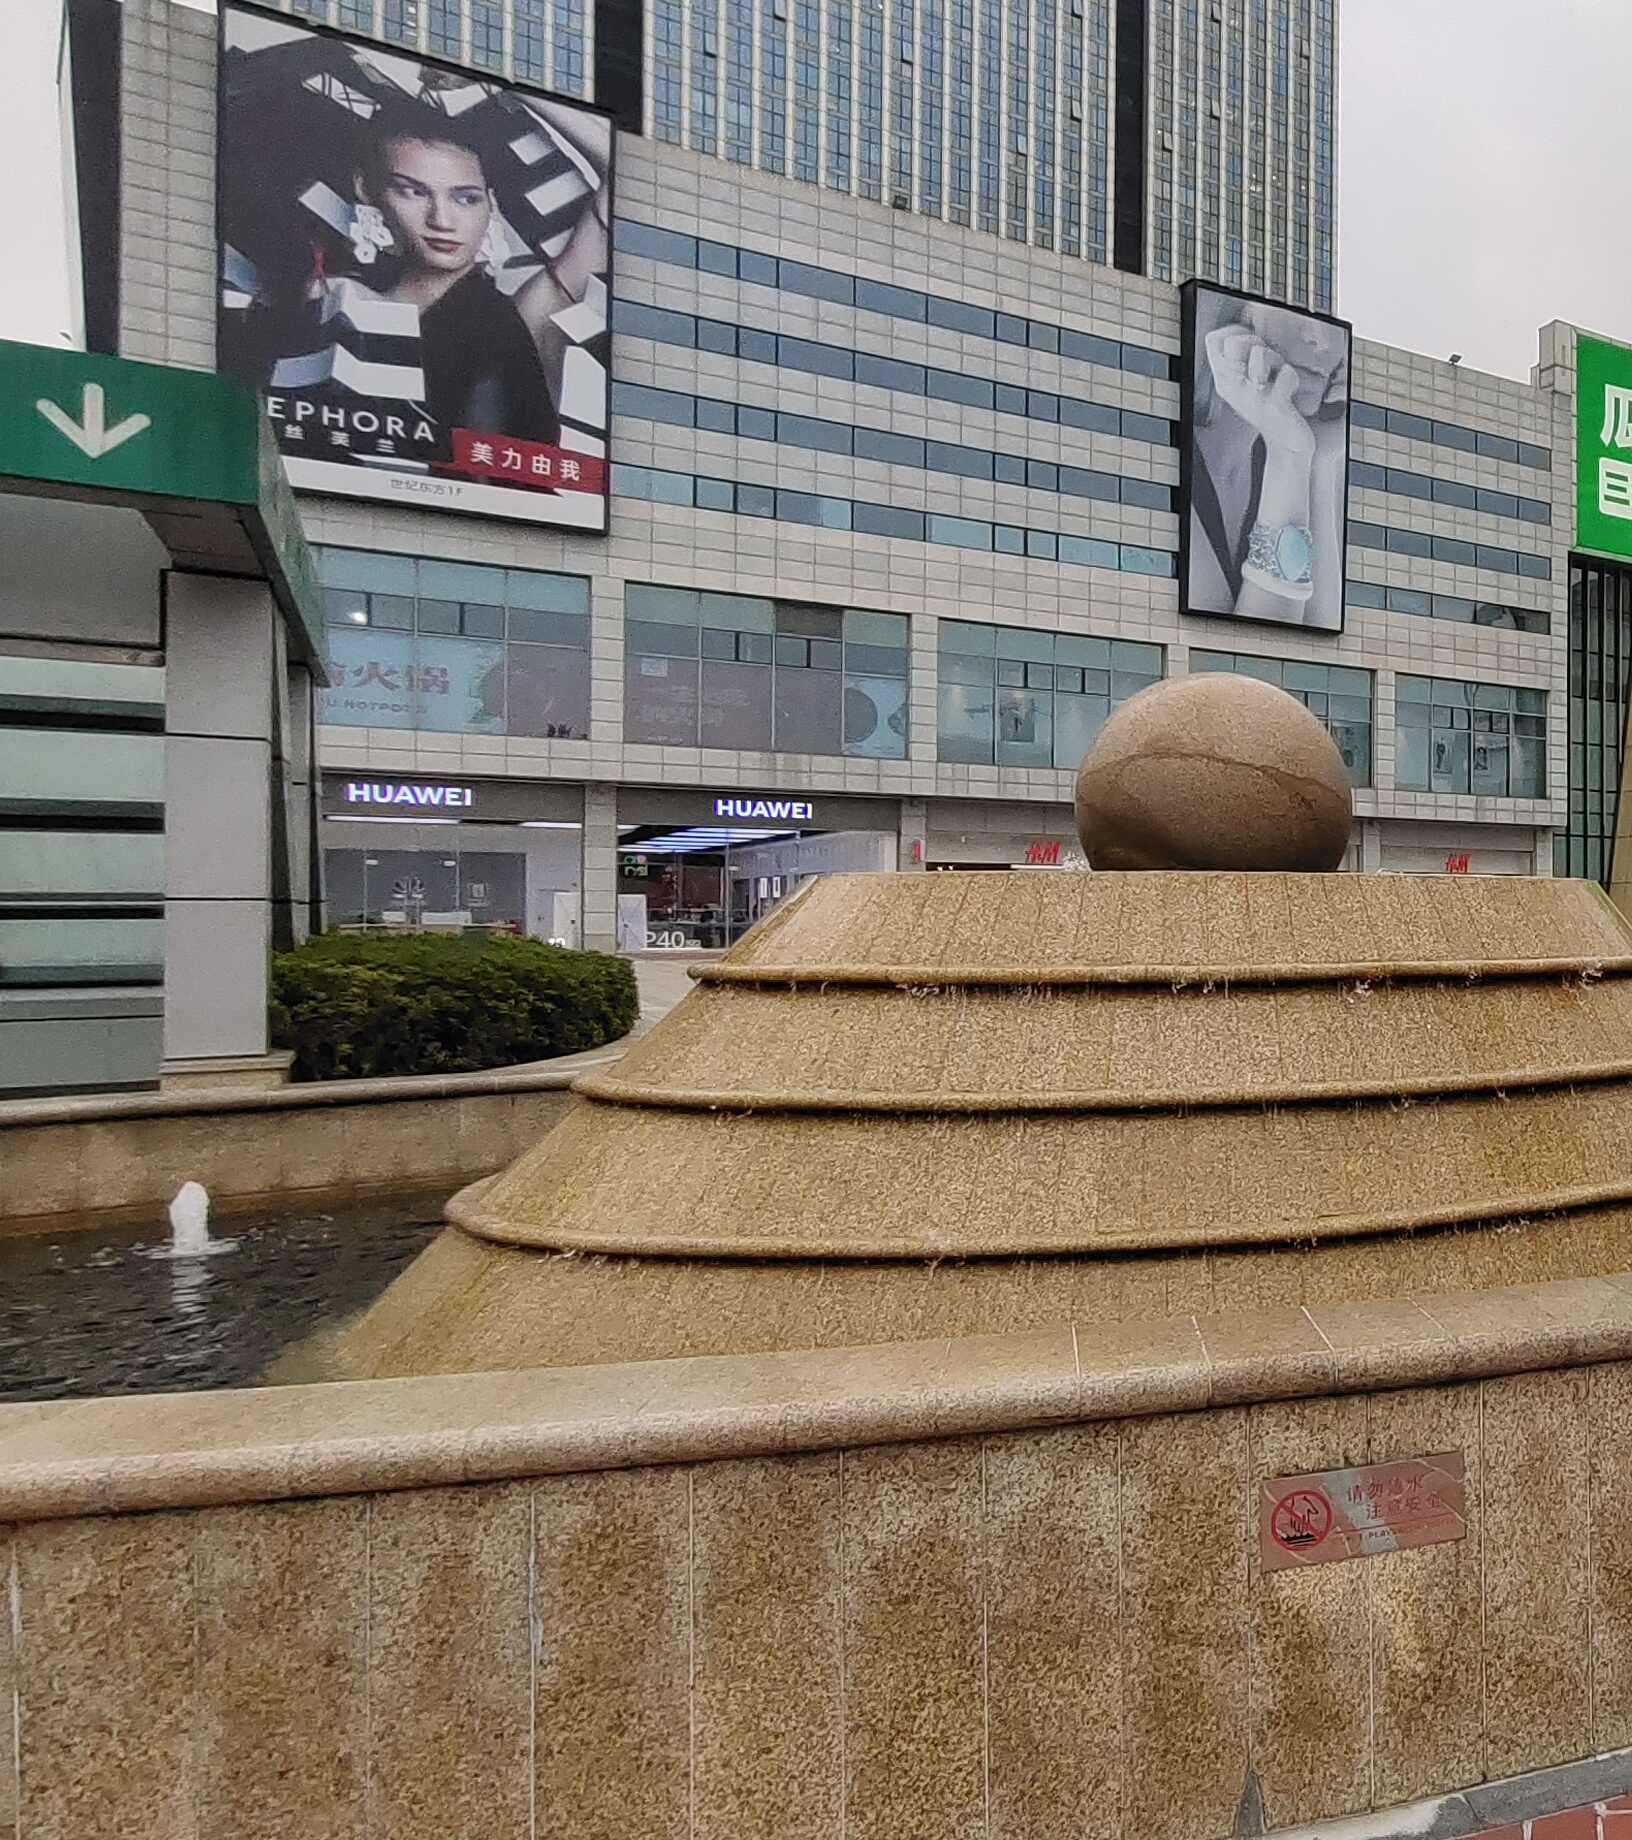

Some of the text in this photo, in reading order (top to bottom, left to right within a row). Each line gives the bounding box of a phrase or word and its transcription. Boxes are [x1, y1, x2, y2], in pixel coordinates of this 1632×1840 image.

[267, 396, 435, 443] EPHORA
[284, 423, 396, 454] 丝芙兰
[470, 441, 581, 482] 美力由我
[346, 783, 472, 807] HUAWEI
[714, 799, 813, 820] HUAWEI
[1025, 841, 1062, 863] H&M
[645, 930, 685, 949] P40
